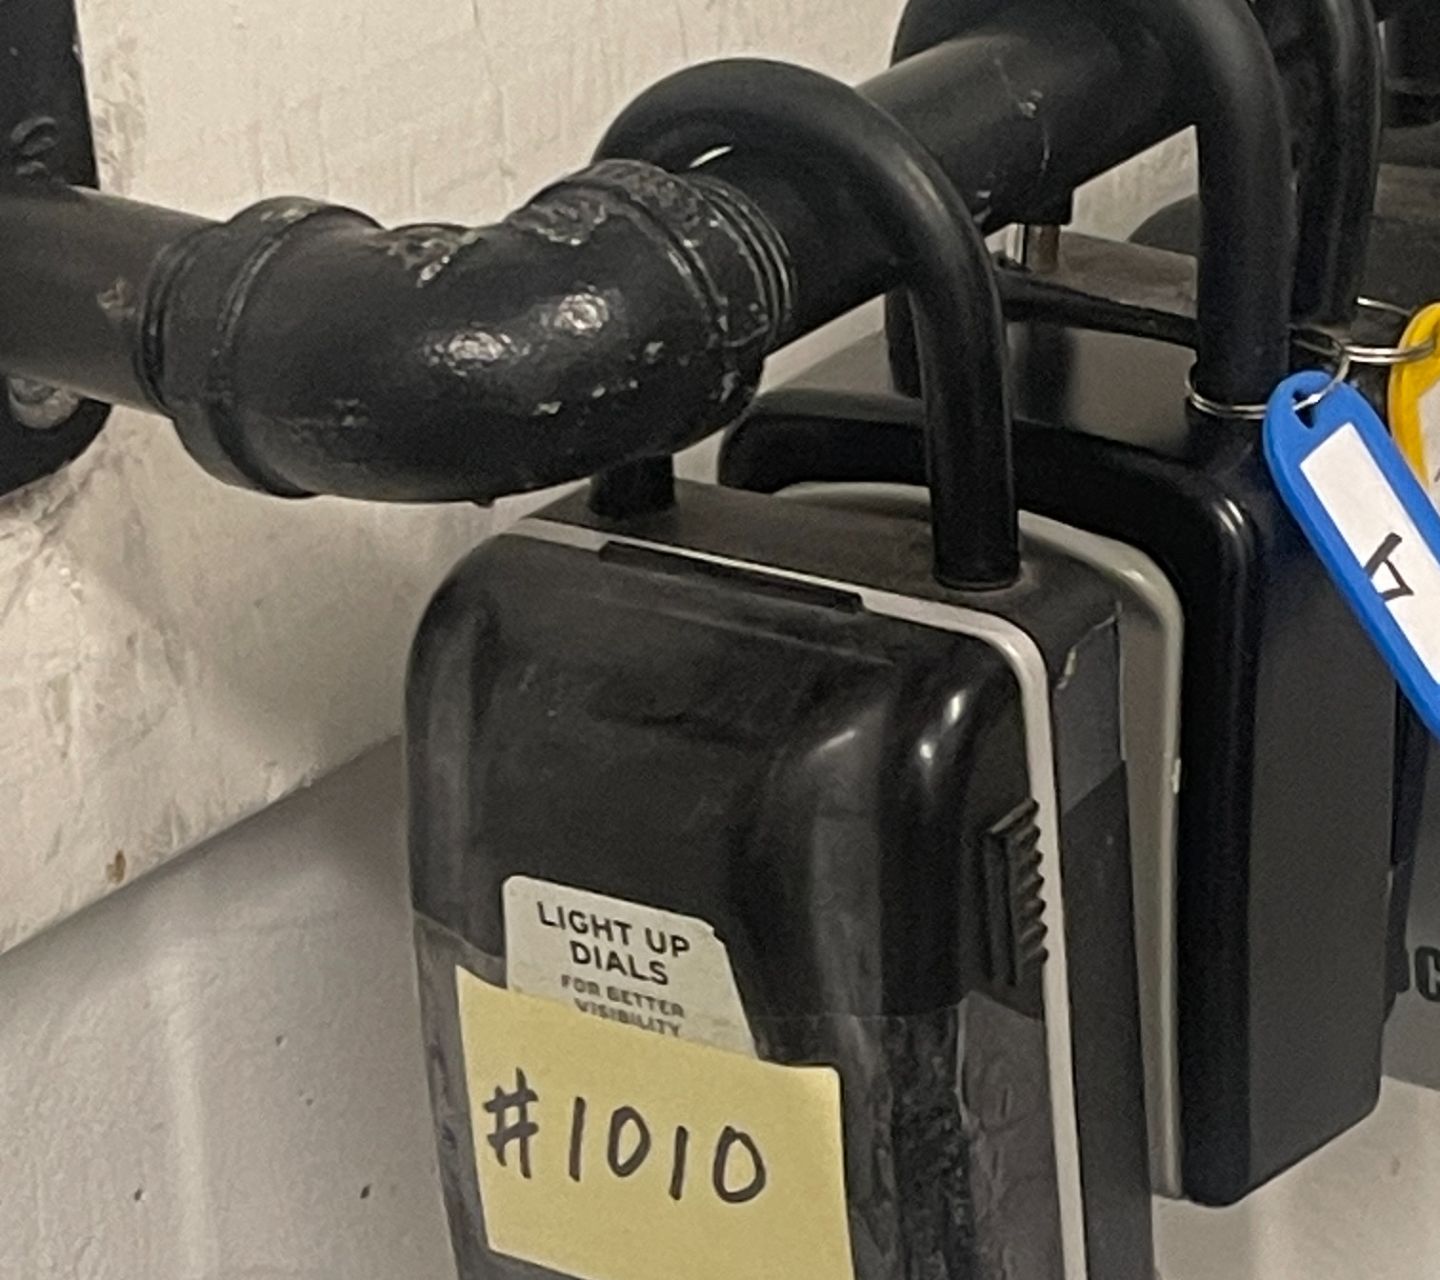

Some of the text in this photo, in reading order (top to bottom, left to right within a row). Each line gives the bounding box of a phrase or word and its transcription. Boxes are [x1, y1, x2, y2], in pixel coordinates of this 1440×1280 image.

[535, 899, 692, 960] LIGHT UP
[568, 939, 670, 986] DIALS
[559, 972, 686, 1020] FOR BETTER
[481, 1065, 767, 1205] #1010
